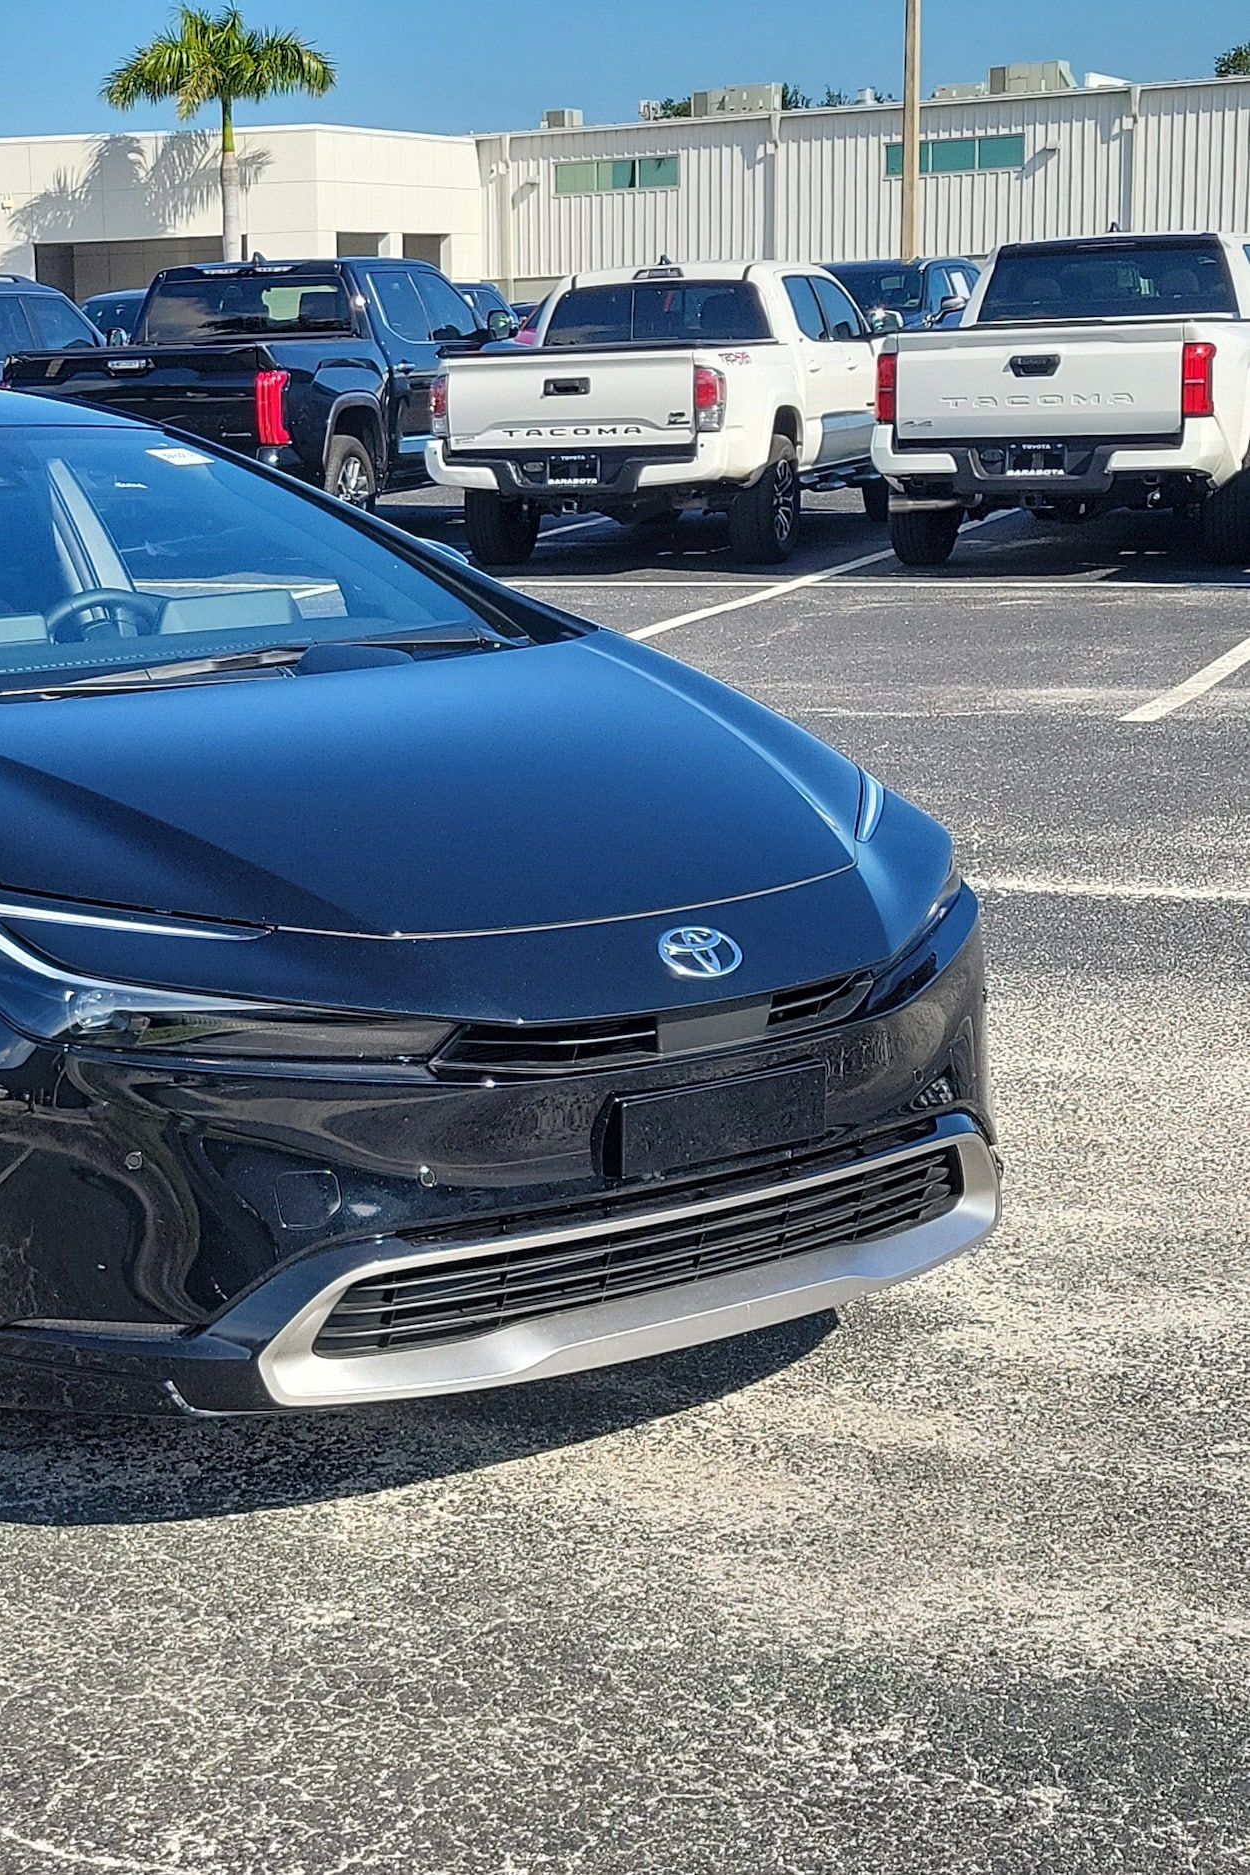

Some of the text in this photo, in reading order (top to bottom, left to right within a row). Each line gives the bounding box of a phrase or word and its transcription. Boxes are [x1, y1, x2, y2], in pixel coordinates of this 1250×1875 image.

[940, 392, 1135, 409] TACOMA
[502, 426, 643, 438] TACOMA
[1006, 468, 1065, 476] SARASOTA
